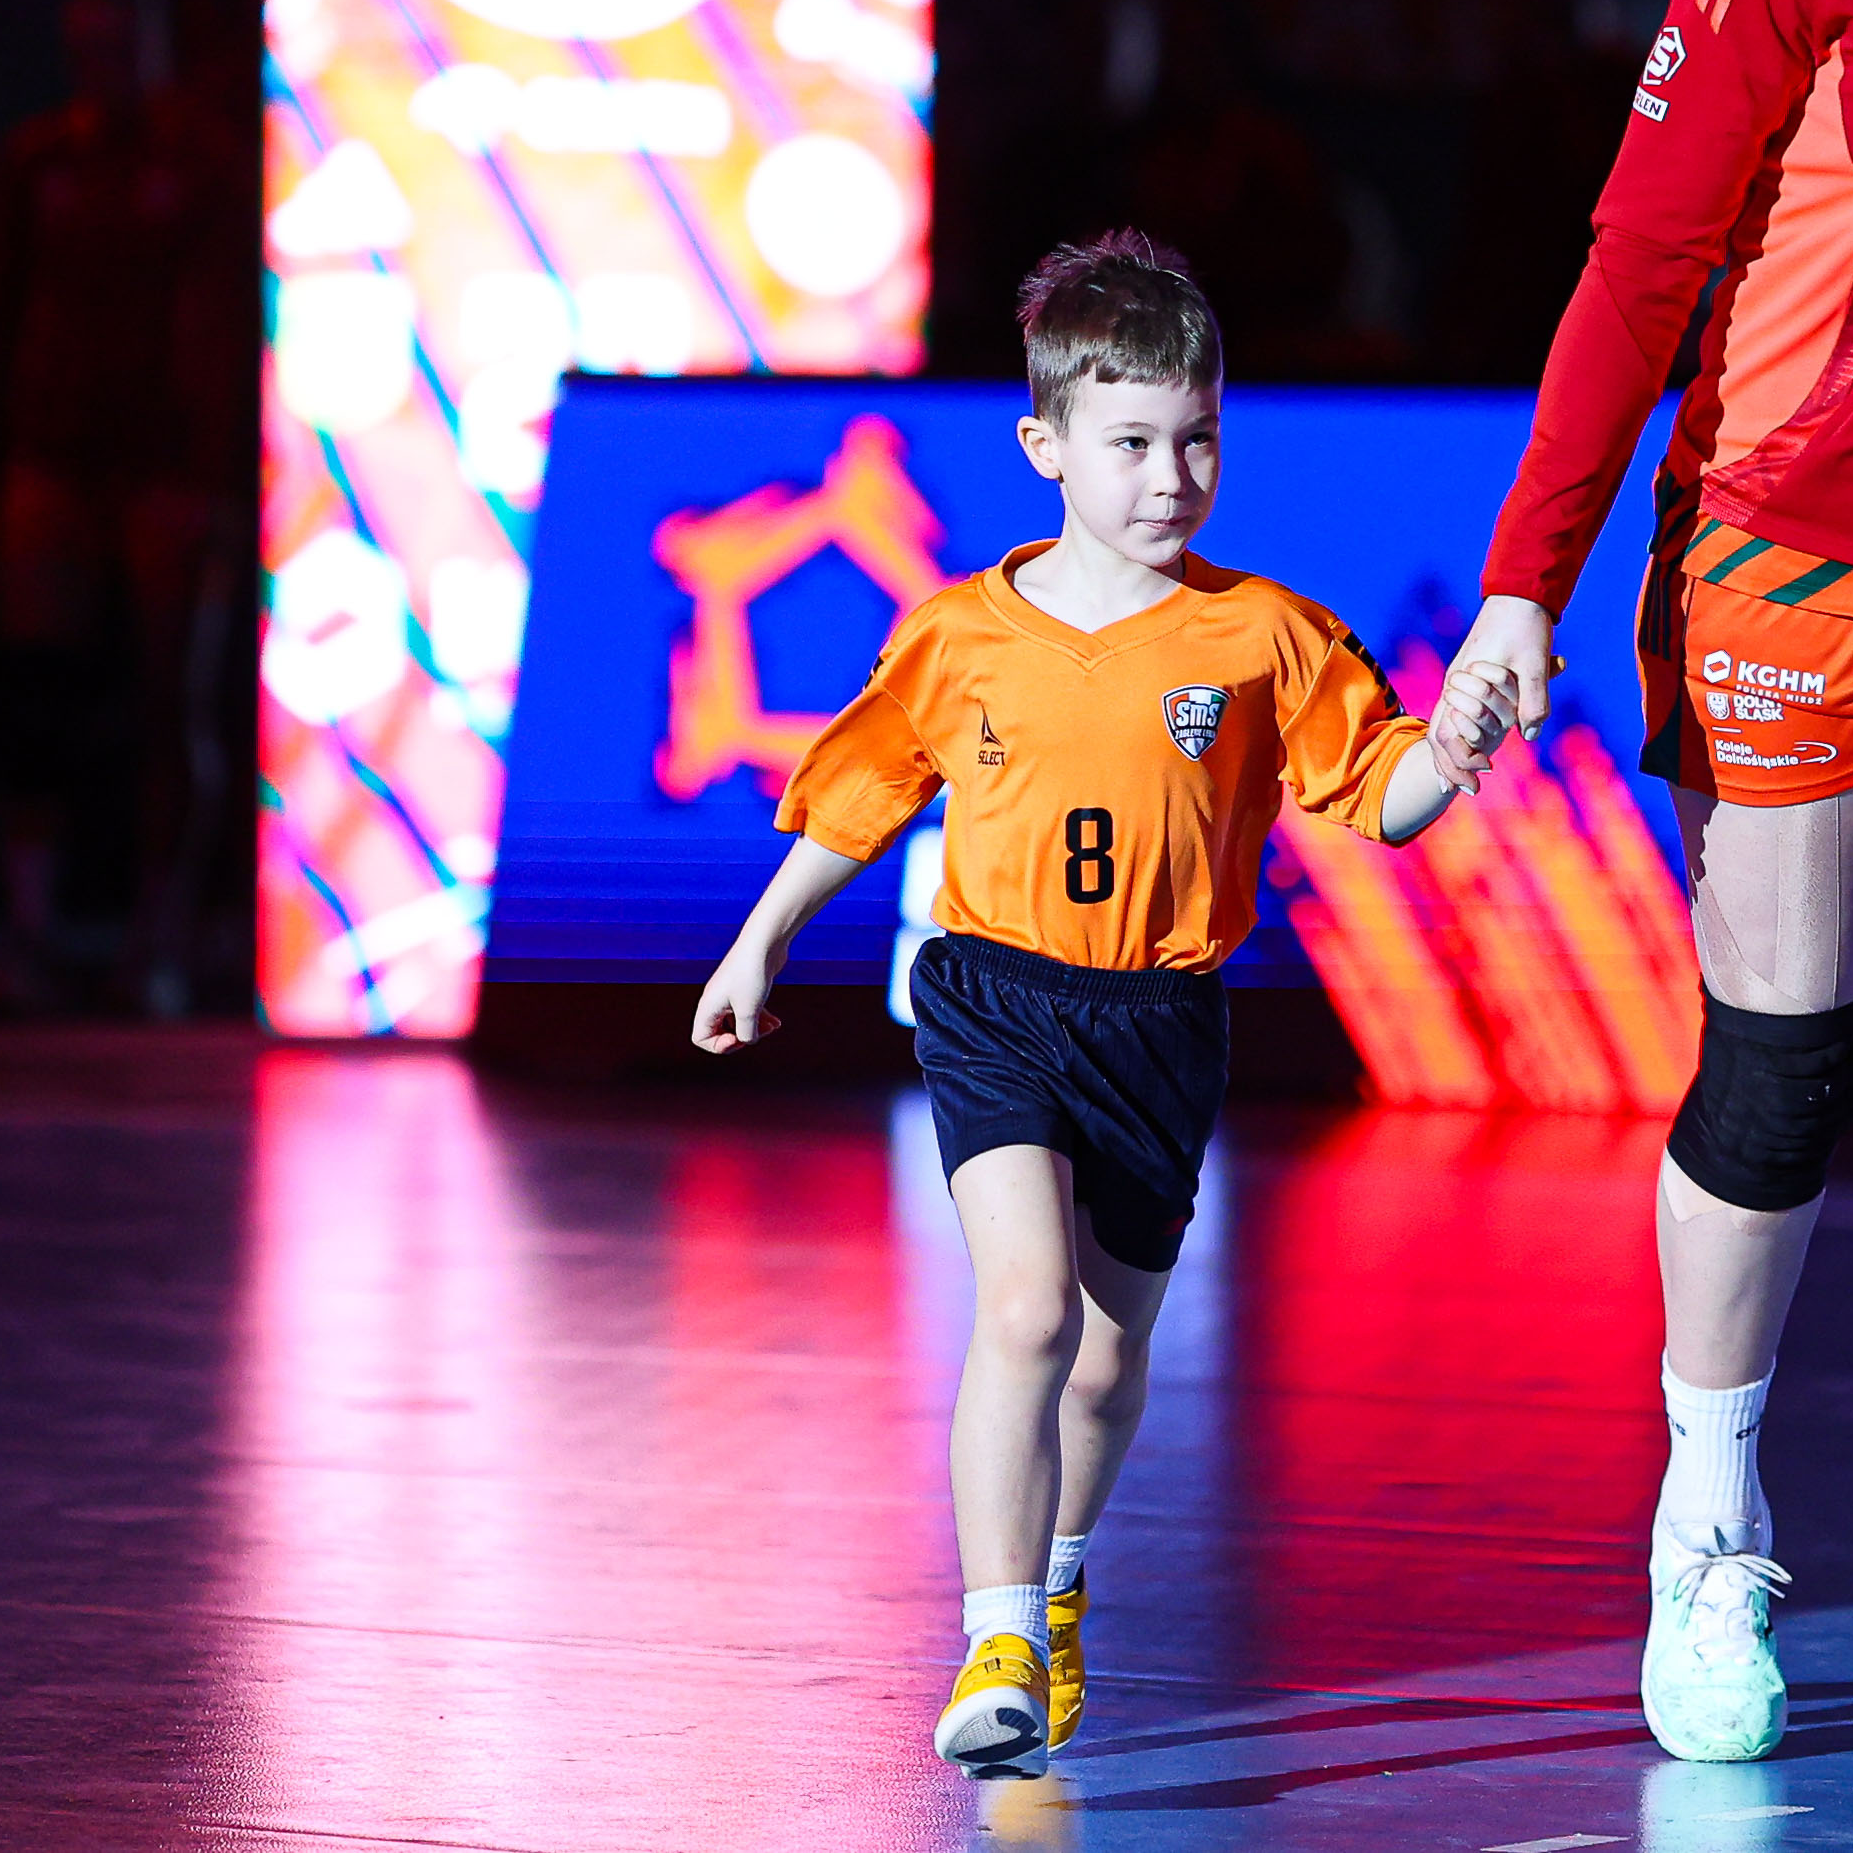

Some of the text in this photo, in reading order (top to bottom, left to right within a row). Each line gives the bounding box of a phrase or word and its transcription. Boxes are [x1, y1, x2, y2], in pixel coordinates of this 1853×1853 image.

[1736, 660, 1827, 695] KGHM
[978, 750, 1005, 766] SELECT
[1065, 807, 1115, 904] 8
